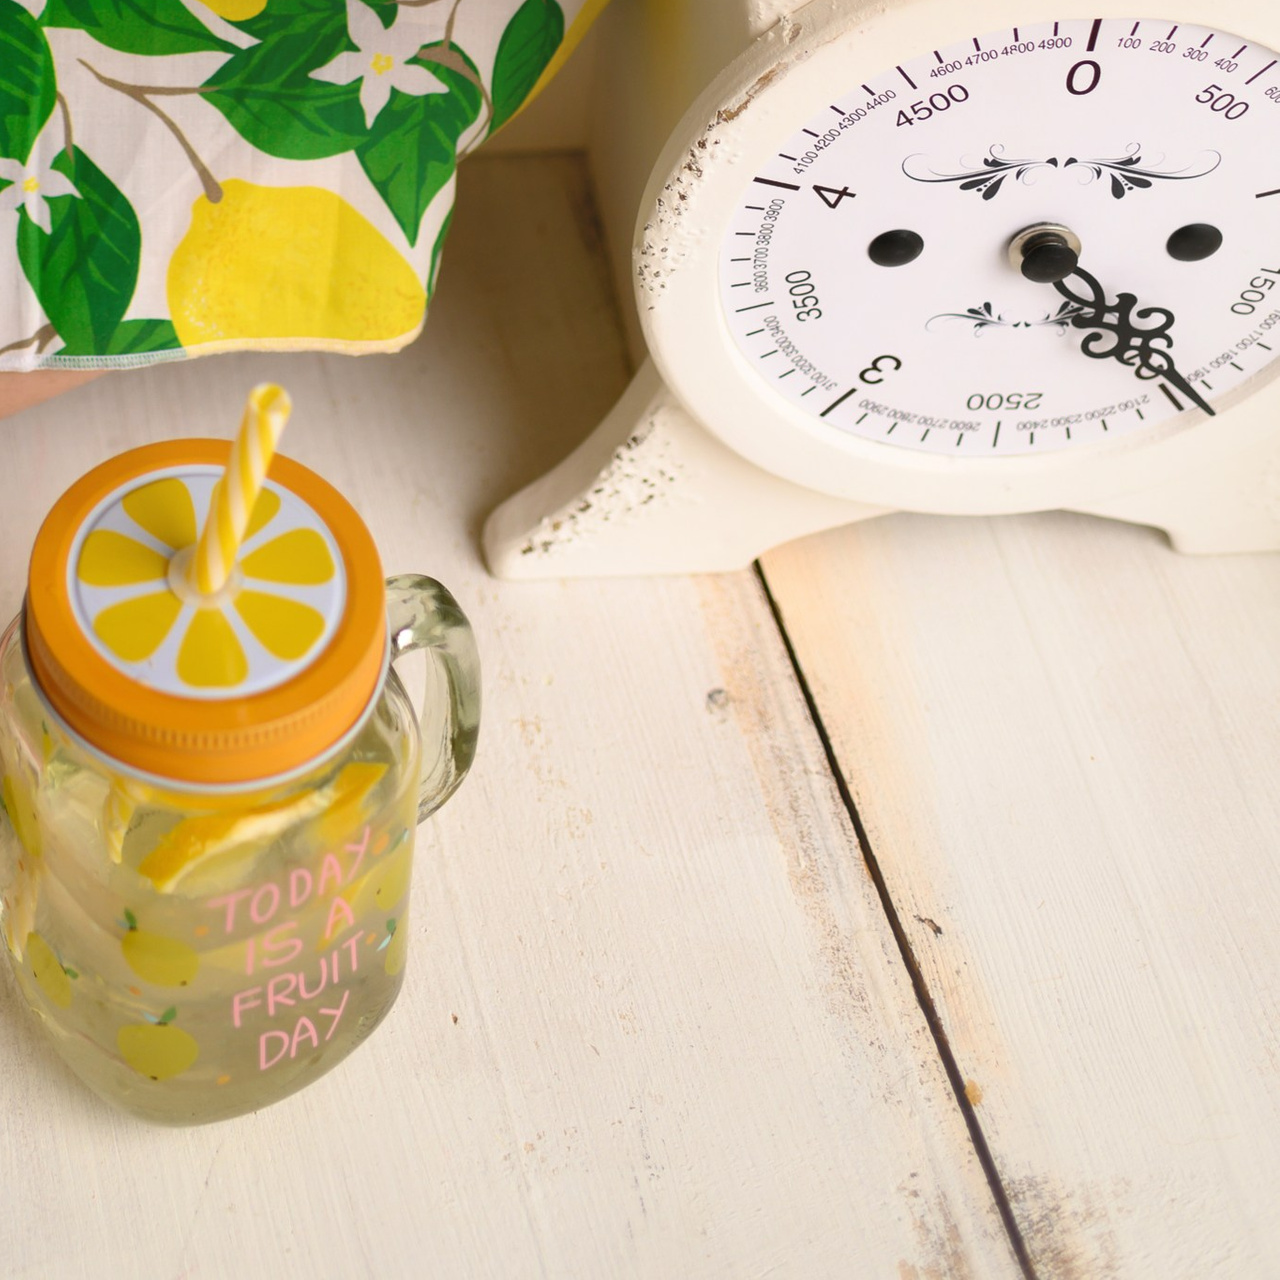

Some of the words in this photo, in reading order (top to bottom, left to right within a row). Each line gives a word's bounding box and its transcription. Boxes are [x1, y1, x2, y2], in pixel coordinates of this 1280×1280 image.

[1038, 37, 1072, 49] 4900
[1117, 37, 1141, 49] 100
[1149, 41, 1176, 53] 200
[965, 49, 998, 66] 4700
[1182, 47, 1208, 62] 300
[1214, 58, 1238, 73] 400
[930, 60, 962, 78] 4600
[1066, 60, 1101, 96] 0
[866, 89, 896, 110] 4400
[896, 84, 969, 128] 4500
[1195, 84, 1249, 120] 500
[838, 107, 867, 131] 4300
[813, 128, 841, 153] 4200
[793, 150, 818, 175] 4100
[812, 185, 857, 209] 4
[764, 198, 785, 222] 3900
[756, 223, 774, 246] 3800
[753, 247, 768, 270] 3700
[753, 270, 768, 293] 3600
[1230, 268, 1280, 316] 1500
[785, 270, 822, 322] 3500
[763, 315, 785, 337] 3400
[775, 336, 798, 358] 3300
[1236, 330, 1263, 351] 1700
[791, 354, 816, 376] 3200
[859, 355, 902, 384] 3
[1209, 349, 1238, 370] 1800
[810, 371, 838, 391] 3100
[859, 398, 889, 415] 2900
[966, 393, 1043, 411] 2500
[1085, 405, 1117, 421] 2200
[1118, 394, 1150, 411] 2100
[887, 408, 918, 424] 2800
[917, 416, 948, 429] 2700
[949, 420, 981, 432] 2600
[1017, 418, 1048, 431] 2400
[1051, 413, 1082, 427] 2300
[207, 826, 371, 933] TODAY
[245, 922, 303, 975] IS
[325, 897, 354, 938] A
[232, 930, 364, 1028] FRUIT
[260, 990, 350, 1071] DAY
